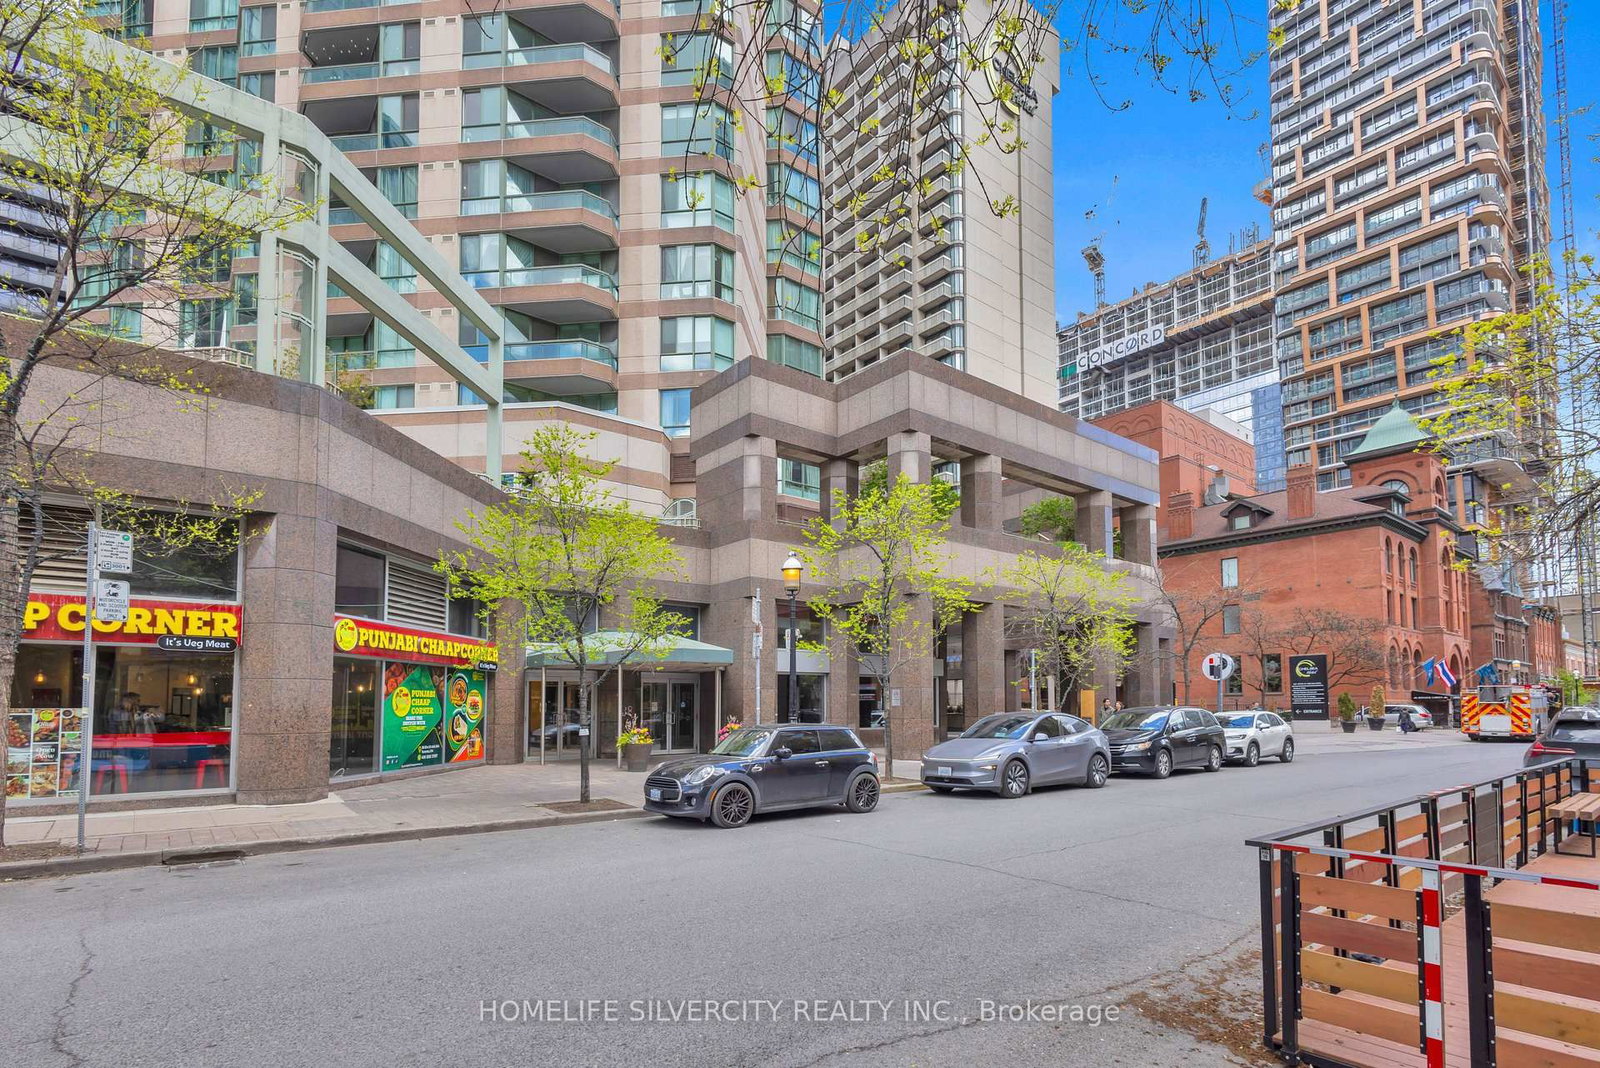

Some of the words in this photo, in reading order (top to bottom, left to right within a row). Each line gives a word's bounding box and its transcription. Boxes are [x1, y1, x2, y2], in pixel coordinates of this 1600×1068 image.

[1078, 328, 1162, 368] CONCORD
[166, 637, 181, 646] It's
[205, 640, 230, 648] Meat
[358, 628, 419, 653] PUNJABI
[420, 637, 461, 657] CHAAP
[411, 690, 436, 698] PUNJABI
[411, 707, 434, 715] CORNER
